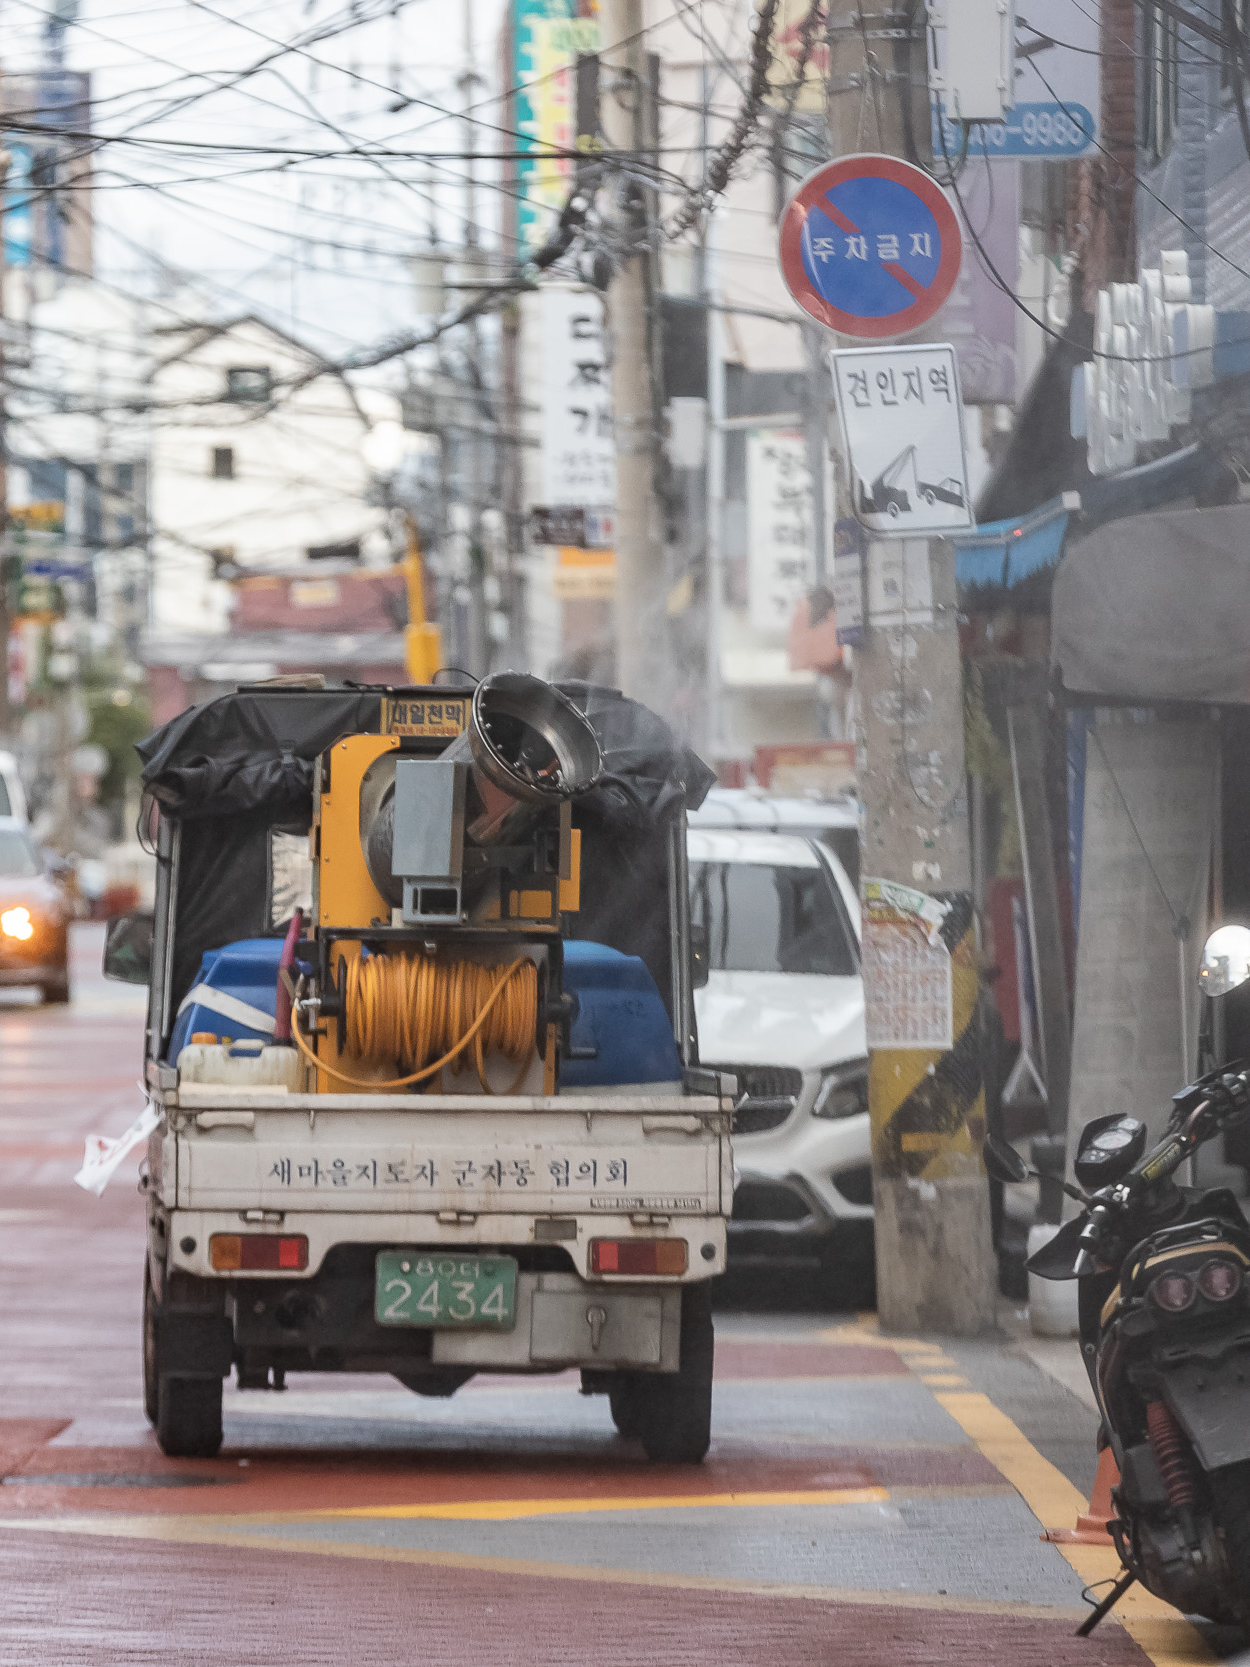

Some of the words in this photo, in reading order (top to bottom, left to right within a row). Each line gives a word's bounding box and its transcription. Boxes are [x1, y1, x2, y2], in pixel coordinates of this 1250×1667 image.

[813, 232, 932, 263] 주차금지
[846, 364, 952, 408] 견인지역
[269, 1157, 439, 1188] 새마을지도자
[452, 1158, 535, 1187] 군자동
[549, 1157, 628, 1188] 협의회
[383, 1278, 509, 1322] 2434
